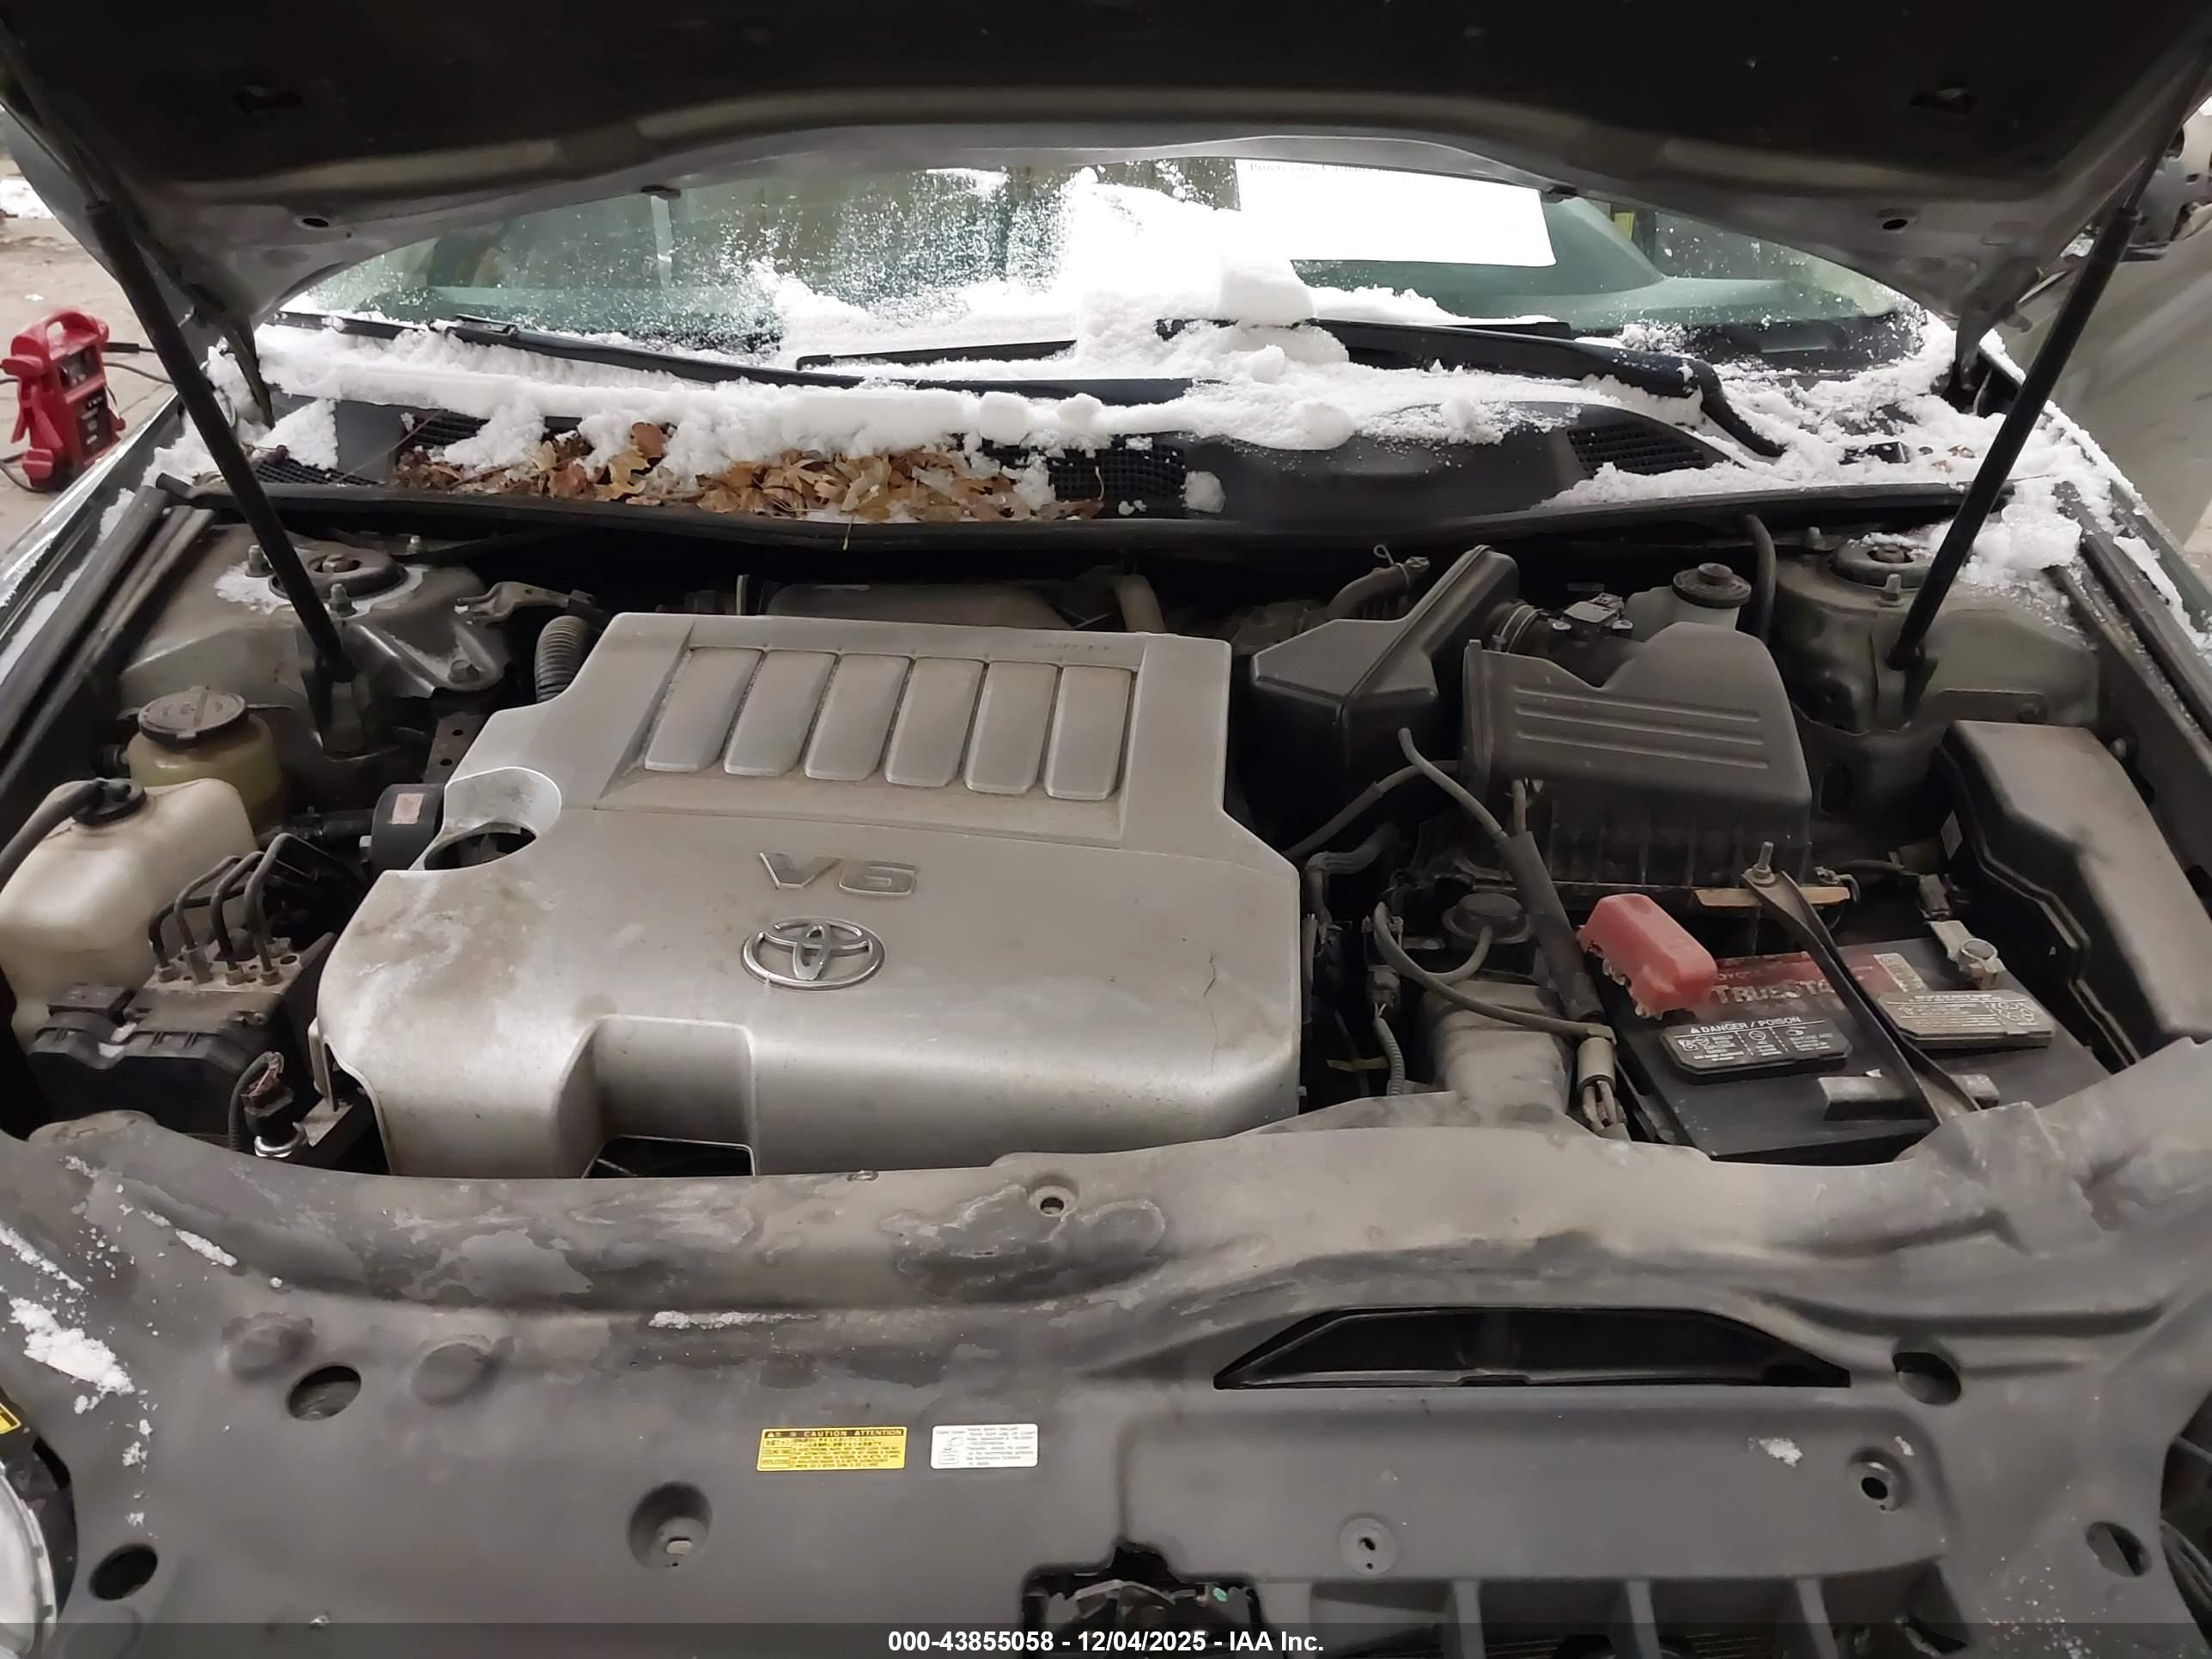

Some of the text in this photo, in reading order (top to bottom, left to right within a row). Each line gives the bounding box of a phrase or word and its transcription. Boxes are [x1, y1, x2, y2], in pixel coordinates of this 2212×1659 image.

[758, 852, 918, 898] V6
[1700, 1022, 1748, 1034] DANGER
[1759, 1016, 1802, 1027] POISON
